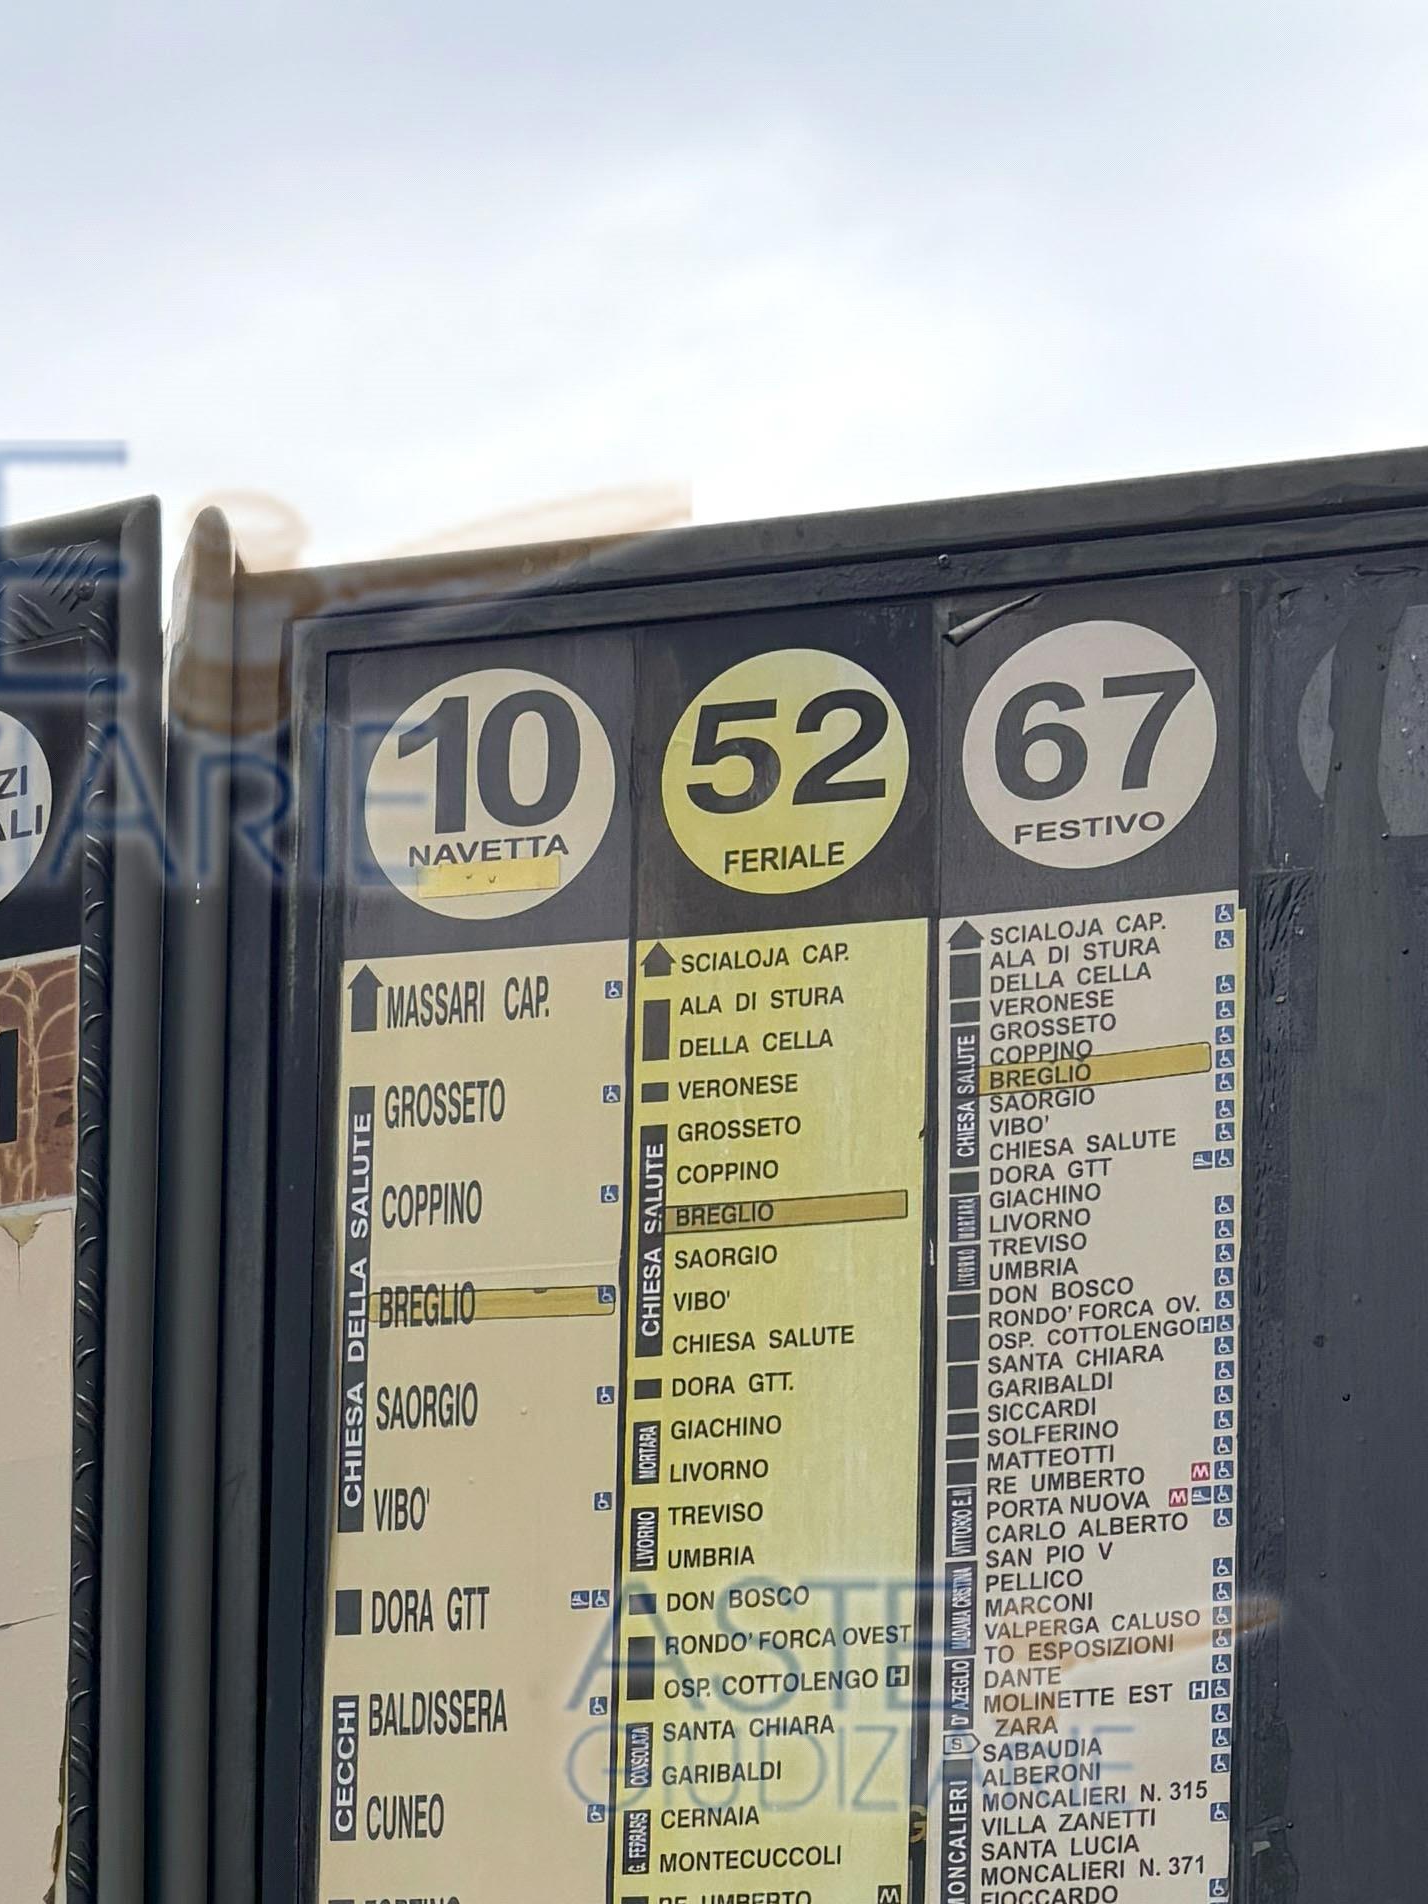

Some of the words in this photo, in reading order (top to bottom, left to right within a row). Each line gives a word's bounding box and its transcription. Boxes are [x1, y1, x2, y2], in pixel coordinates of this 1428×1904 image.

[686, 689, 889, 814] 52
[994, 668, 1196, 801] 67
[397, 689, 581, 835] 10
[1014, 811, 1165, 844] FESTIVO
[408, 834, 569, 867] NAVETTA
[724, 841, 844, 874] FERIALE
[990, 918, 1103, 945] SCIALOJA
[1116, 912, 1166, 933] CAP.
[681, 947, 789, 973] SCIALOJA
[802, 943, 849, 964] CAP.
[387, 980, 484, 1029] MASSARI
[504, 975, 549, 1021] CAP.
[679, 994, 722, 1015] ALA
[736, 992, 756, 1011] DI
[771, 986, 844, 1009] STURA
[384, 1078, 505, 1129] GROSSETO
[678, 1074, 798, 1099] VERONESE
[990, 1138, 1074, 1161] CHIESA
[1086, 1129, 1176, 1152] SALUTE
[352, 1113, 371, 1239] SALUTE
[644, 1143, 663, 1234] SALUTE
[382, 1180, 483, 1229] COPPINO
[347, 1257, 368, 1362] DELLA
[378, 1281, 476, 1329] BREGLIO
[640, 1248, 662, 1336] CHIESA
[672, 1332, 755, 1354] CHIESA
[769, 1325, 854, 1348] SALUTE
[376, 1383, 478, 1430] SAORGIO
[670, 1415, 782, 1440] GIACHINO
[343, 1381, 365, 1508] CHIESA
[987, 1446, 1114, 1471] MATTEOTTI
[373, 1486, 429, 1531] VIBO'
[372, 1588, 433, 1633] DORA
[447, 1586, 489, 1632] GTT
[984, 1644, 1013, 1664] TO
[1029, 1634, 1173, 1661] ESPOSIZIONI
[664, 1679, 711, 1699] OSP.
[722, 1668, 878, 1696] COTTOLENGO
[369, 1689, 507, 1736] BALDISSERA
[335, 1700, 357, 1834] CECCHI
[983, 1737, 1102, 1762] SABAUDIA
[367, 1793, 444, 1840] CUNEO
[982, 1814, 1046, 1836] VILLA
[1059, 1808, 1155, 1831] ZANETTI
[660, 1845, 842, 1873] MONTECUCCOLI
[981, 1860, 1123, 1886] MONCALIERI
[1139, 1858, 1160, 1877] N.
[1168, 1855, 1204, 1875] 371
